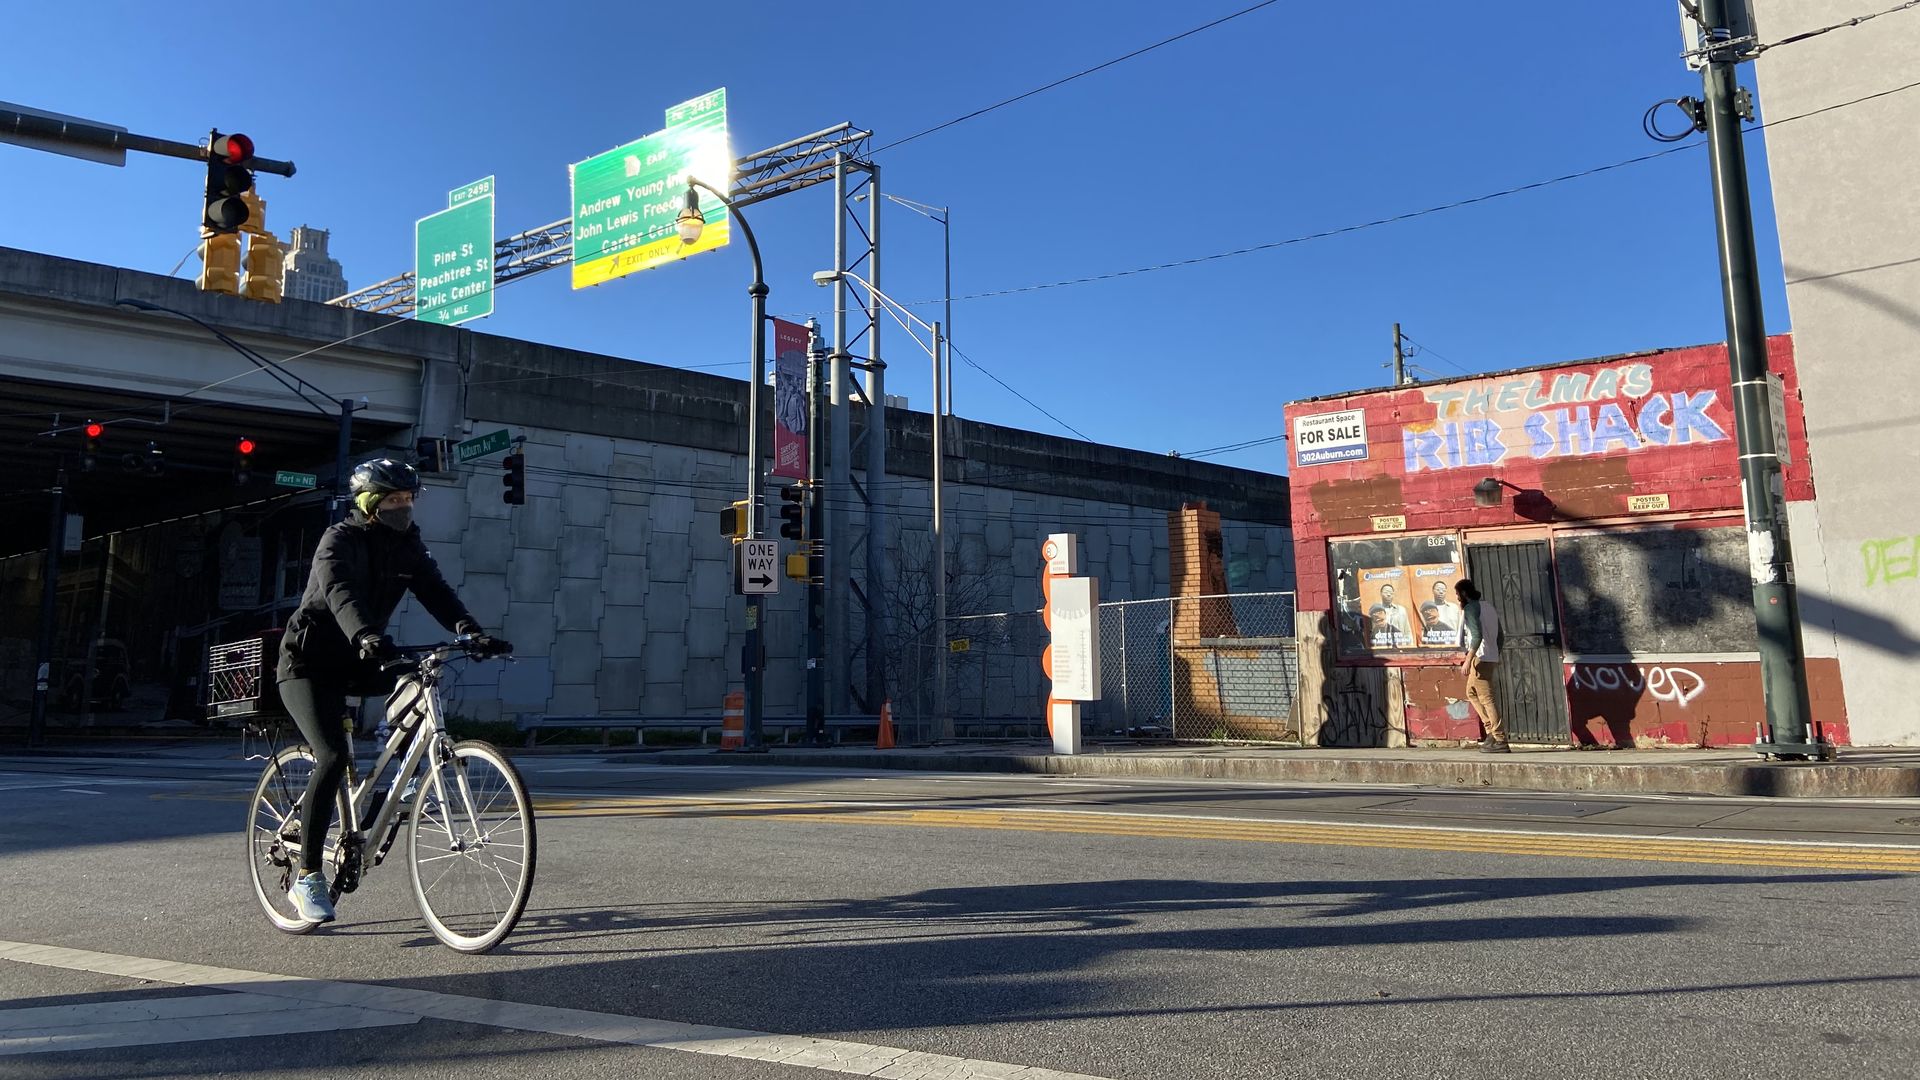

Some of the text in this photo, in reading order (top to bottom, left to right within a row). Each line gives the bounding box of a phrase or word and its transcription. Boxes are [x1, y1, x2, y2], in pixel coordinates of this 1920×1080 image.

[467, 181, 489, 198] 249B
[579, 193, 621, 218] Andrew
[626, 178, 664, 203] Young
[576, 195, 684, 241] John Lewis Freedo
[602, 222, 680, 254] Carter Cent
[434, 242, 474, 267] Pine St
[626, 244, 671, 266] EXIT ONLY
[420, 257, 489, 291] Peachtree St
[422, 280, 487, 309] Civic Center
[438, 304, 469, 322] 3/4 MILE
[780, 333, 802, 344] LEGACY
[1425, 362, 1653, 420] THELMA'S
[1302, 413, 1356, 427] Restaurant Space
[1300, 425, 1361, 445] FOR SALE
[1402, 389, 1730, 472] RIB SHACK
[460, 443, 482, 459] Auburn
[482, 439, 491, 452] Av
[1301, 448, 1363, 463] 302Auburn.com
[277, 473, 294, 483] Fort
[302, 476, 315, 486] NE
[748, 543, 774, 557] ONE
[1428, 538, 1445, 546] 302
[748, 558, 774, 571] WAY
